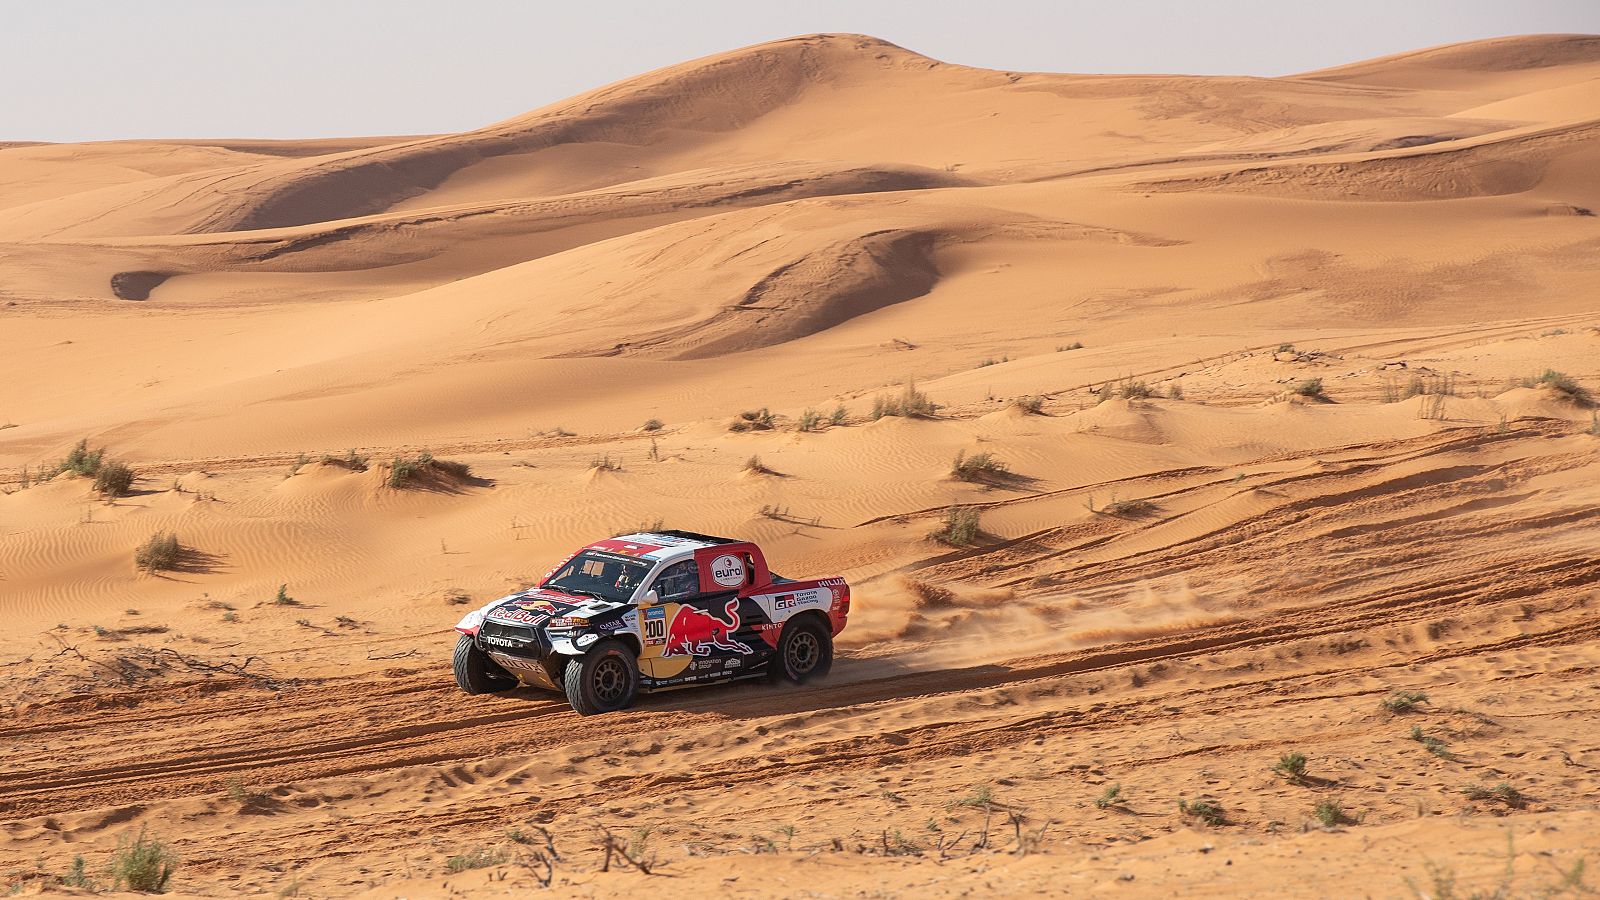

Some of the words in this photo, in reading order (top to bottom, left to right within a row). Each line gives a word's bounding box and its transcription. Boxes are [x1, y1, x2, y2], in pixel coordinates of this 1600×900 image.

[715, 566, 743, 578] eurol
[818, 578, 845, 588] HILUX
[776, 599, 796, 609] GR
[599, 619, 622, 630] QATAR
[761, 622, 783, 631] KINTO
[487, 636, 513, 648] TOYOTA
